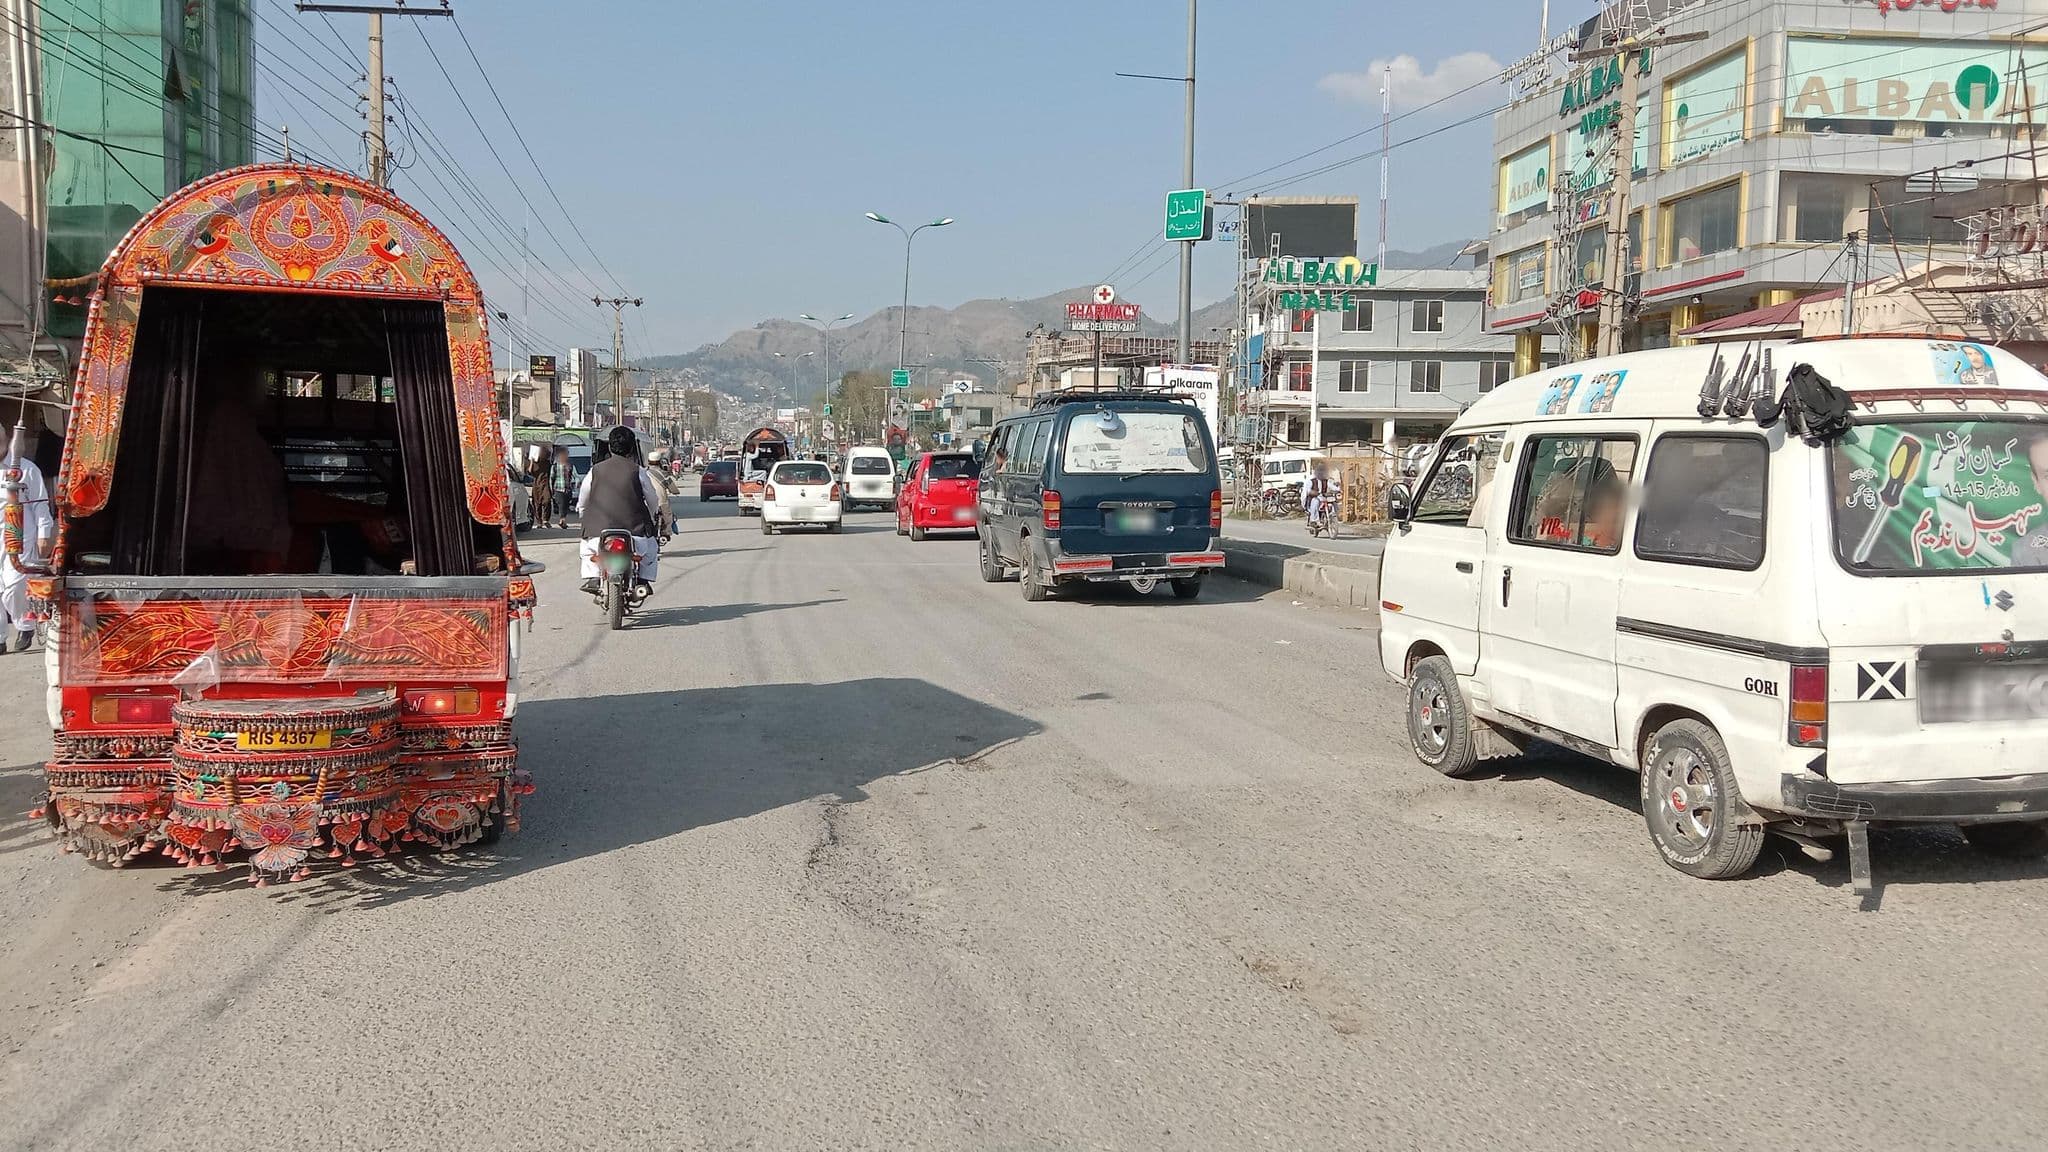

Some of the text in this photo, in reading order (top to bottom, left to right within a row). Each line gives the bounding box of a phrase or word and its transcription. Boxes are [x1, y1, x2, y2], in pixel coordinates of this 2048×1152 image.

[1547, 28, 1580, 54] KHAN
[1068, 303, 1140, 320] PHARMACY
[1072, 321, 1090, 331] HOME
[1170, 378, 1213, 390] alkaram
[1944, 482, 1985, 497] 14-15
[1540, 517, 1561, 535] VIP
[1955, 502, 2042, 557] سہیل
[1744, 677, 1778, 697] GORI
[248, 731, 317, 746] RIS 4367
